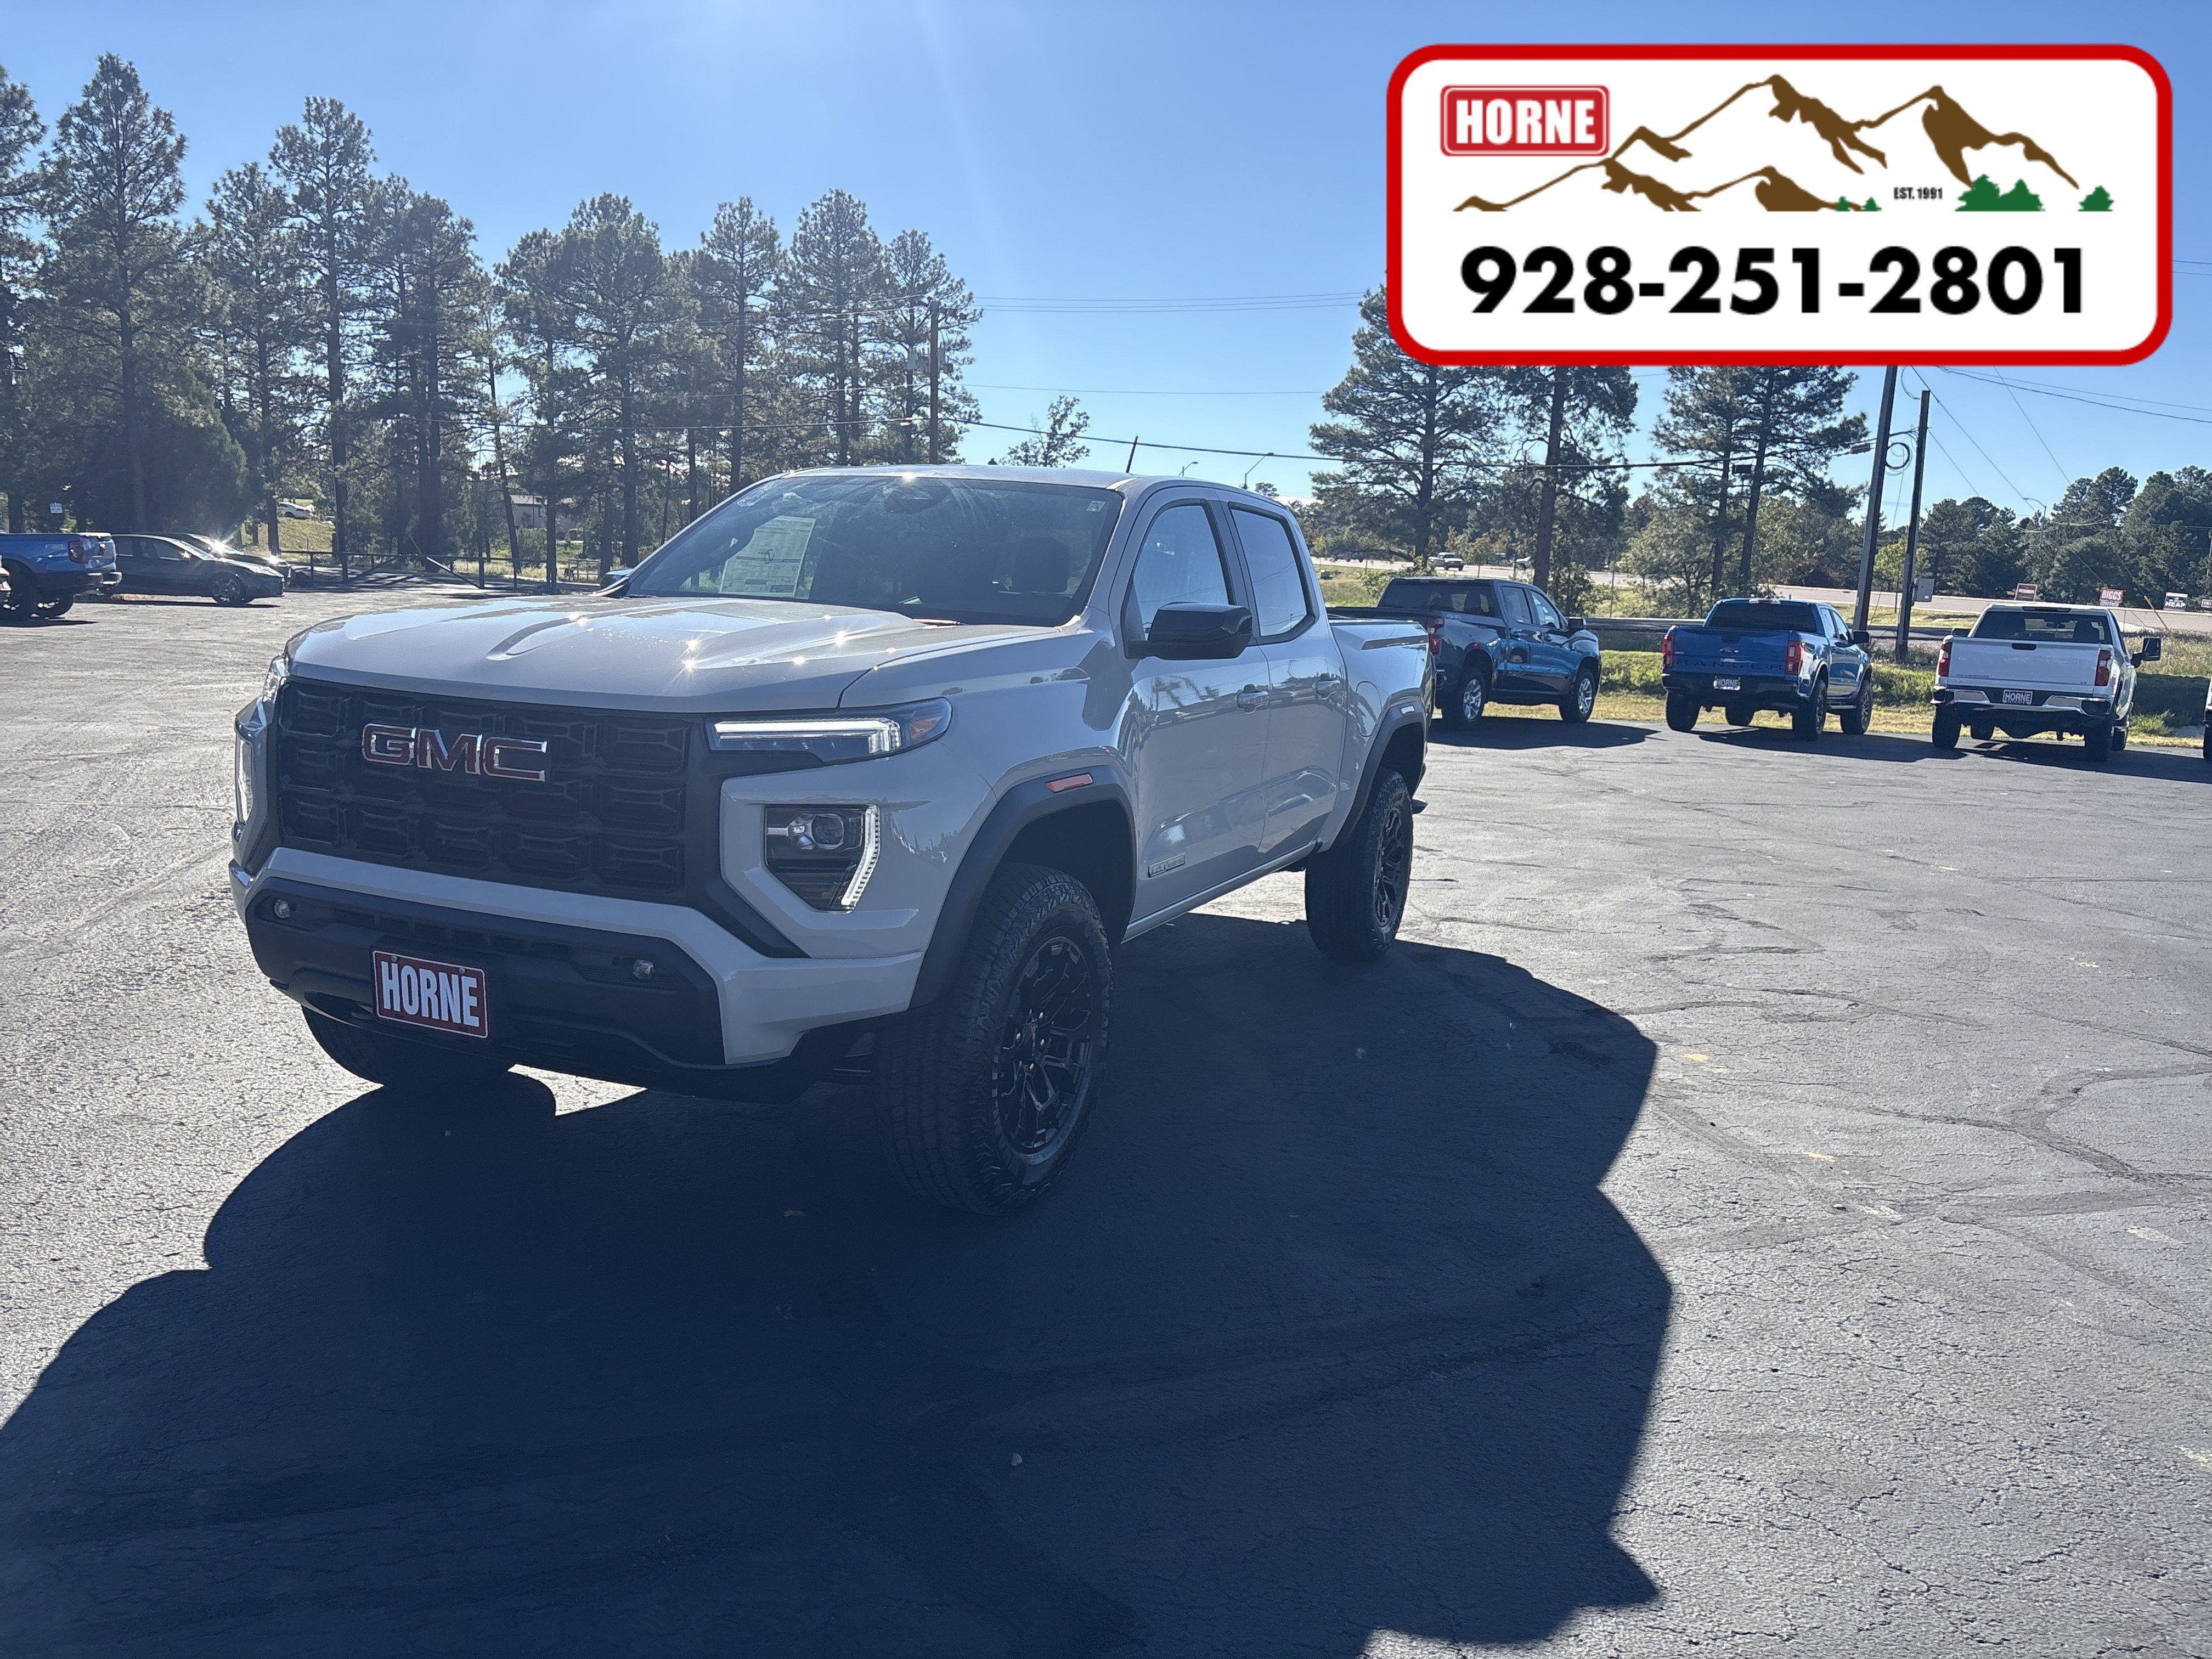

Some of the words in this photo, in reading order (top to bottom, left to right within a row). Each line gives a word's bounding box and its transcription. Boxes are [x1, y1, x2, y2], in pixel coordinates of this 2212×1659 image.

[2101, 590, 2122, 601] BIGGS
[1716, 678, 1739, 687] HORNE
[2005, 692, 2031, 702] HORNE
[362, 723, 548, 782] GMC
[381, 961, 479, 1027] HORNE
